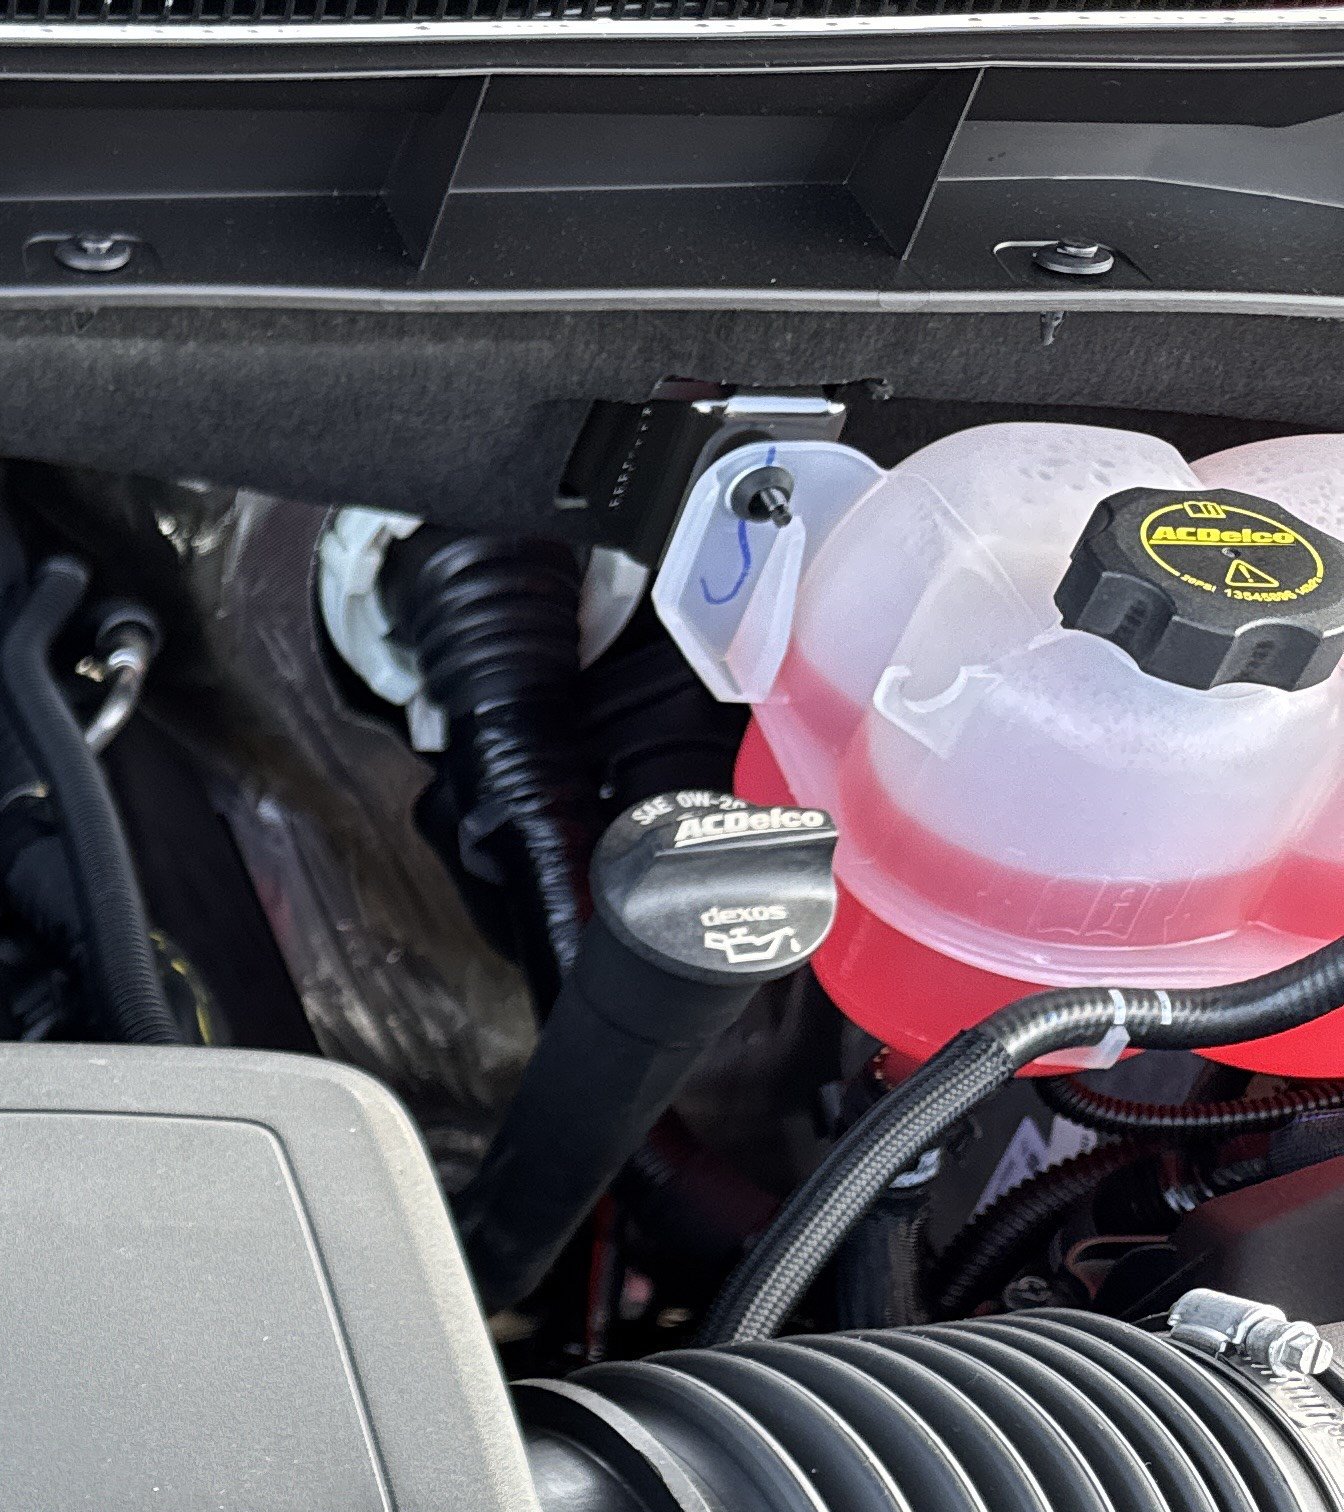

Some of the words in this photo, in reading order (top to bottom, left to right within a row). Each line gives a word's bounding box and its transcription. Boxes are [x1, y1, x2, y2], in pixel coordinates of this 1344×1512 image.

[1150, 526, 1296, 544] ACDelco
[631, 795, 675, 825] SAE
[674, 807, 825, 842] ACDelco
[700, 904, 788, 927] dexos
